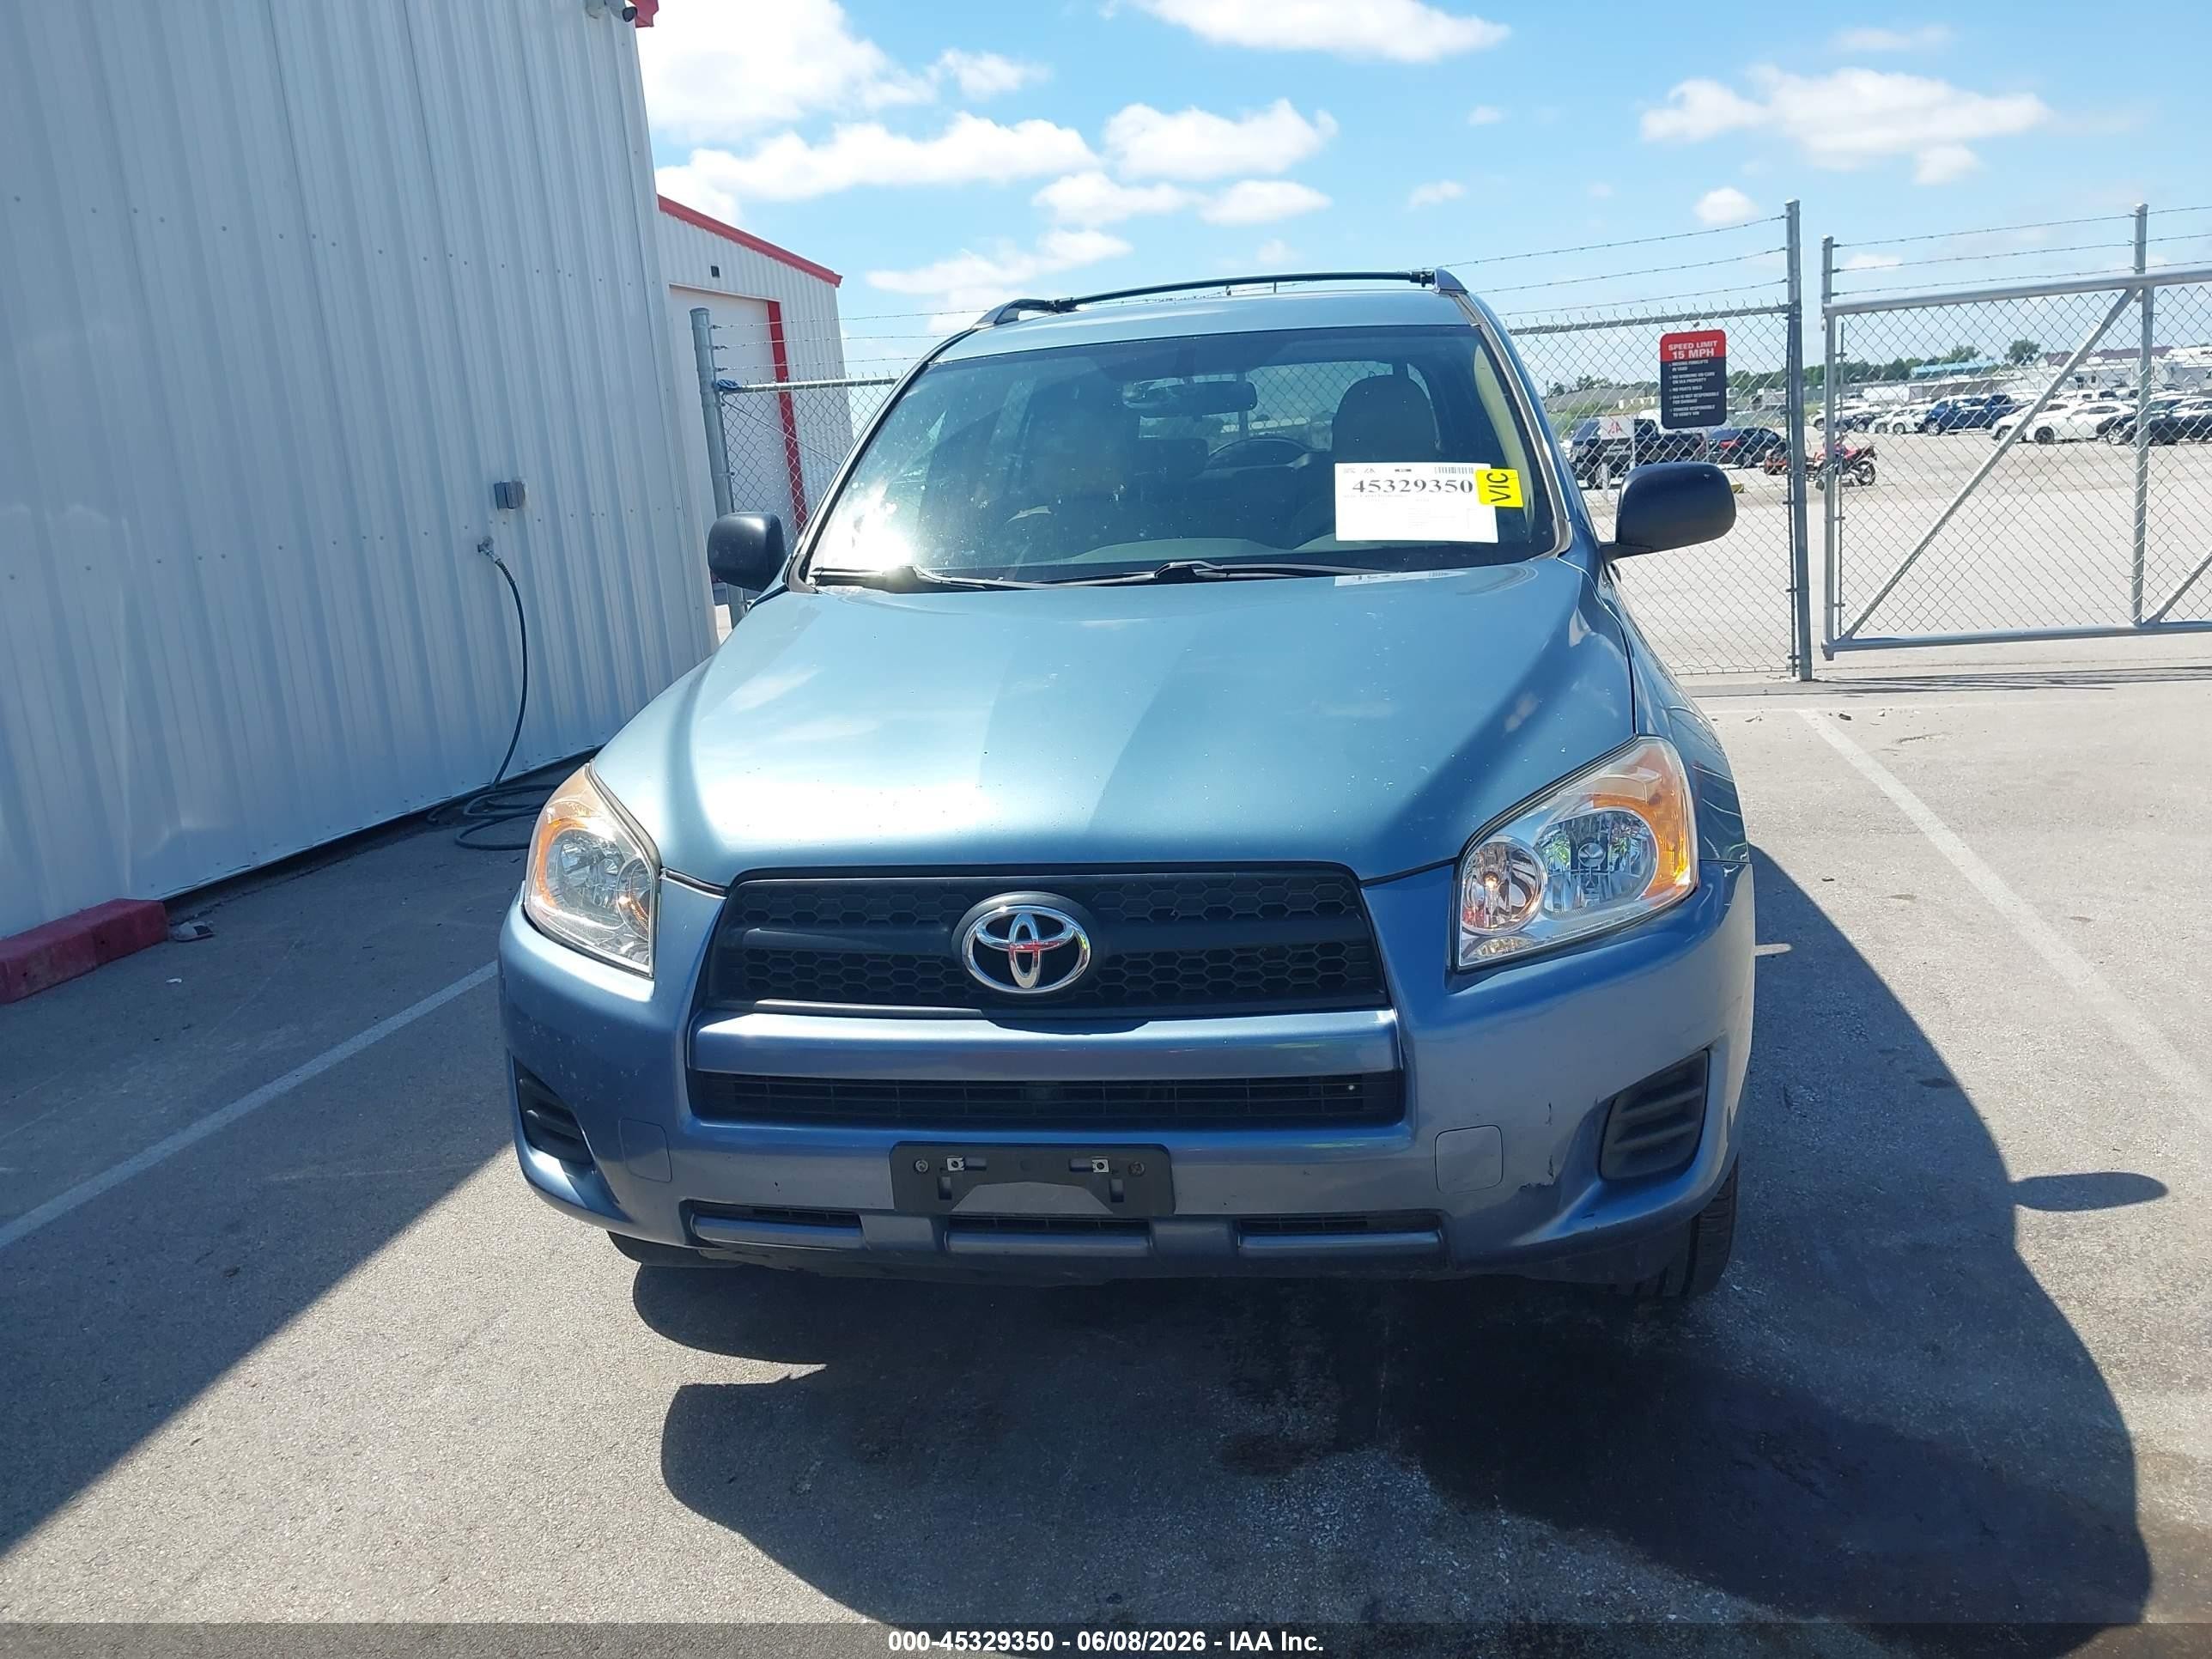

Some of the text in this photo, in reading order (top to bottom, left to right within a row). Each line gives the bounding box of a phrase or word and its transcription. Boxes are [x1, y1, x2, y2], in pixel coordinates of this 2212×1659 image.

[1668, 340, 1717, 350] SPEED LIMIT
[1673, 349, 1714, 360] 15 MPH
[1352, 479, 1474, 493] 45329350
[1486, 472, 1512, 502] VIC
